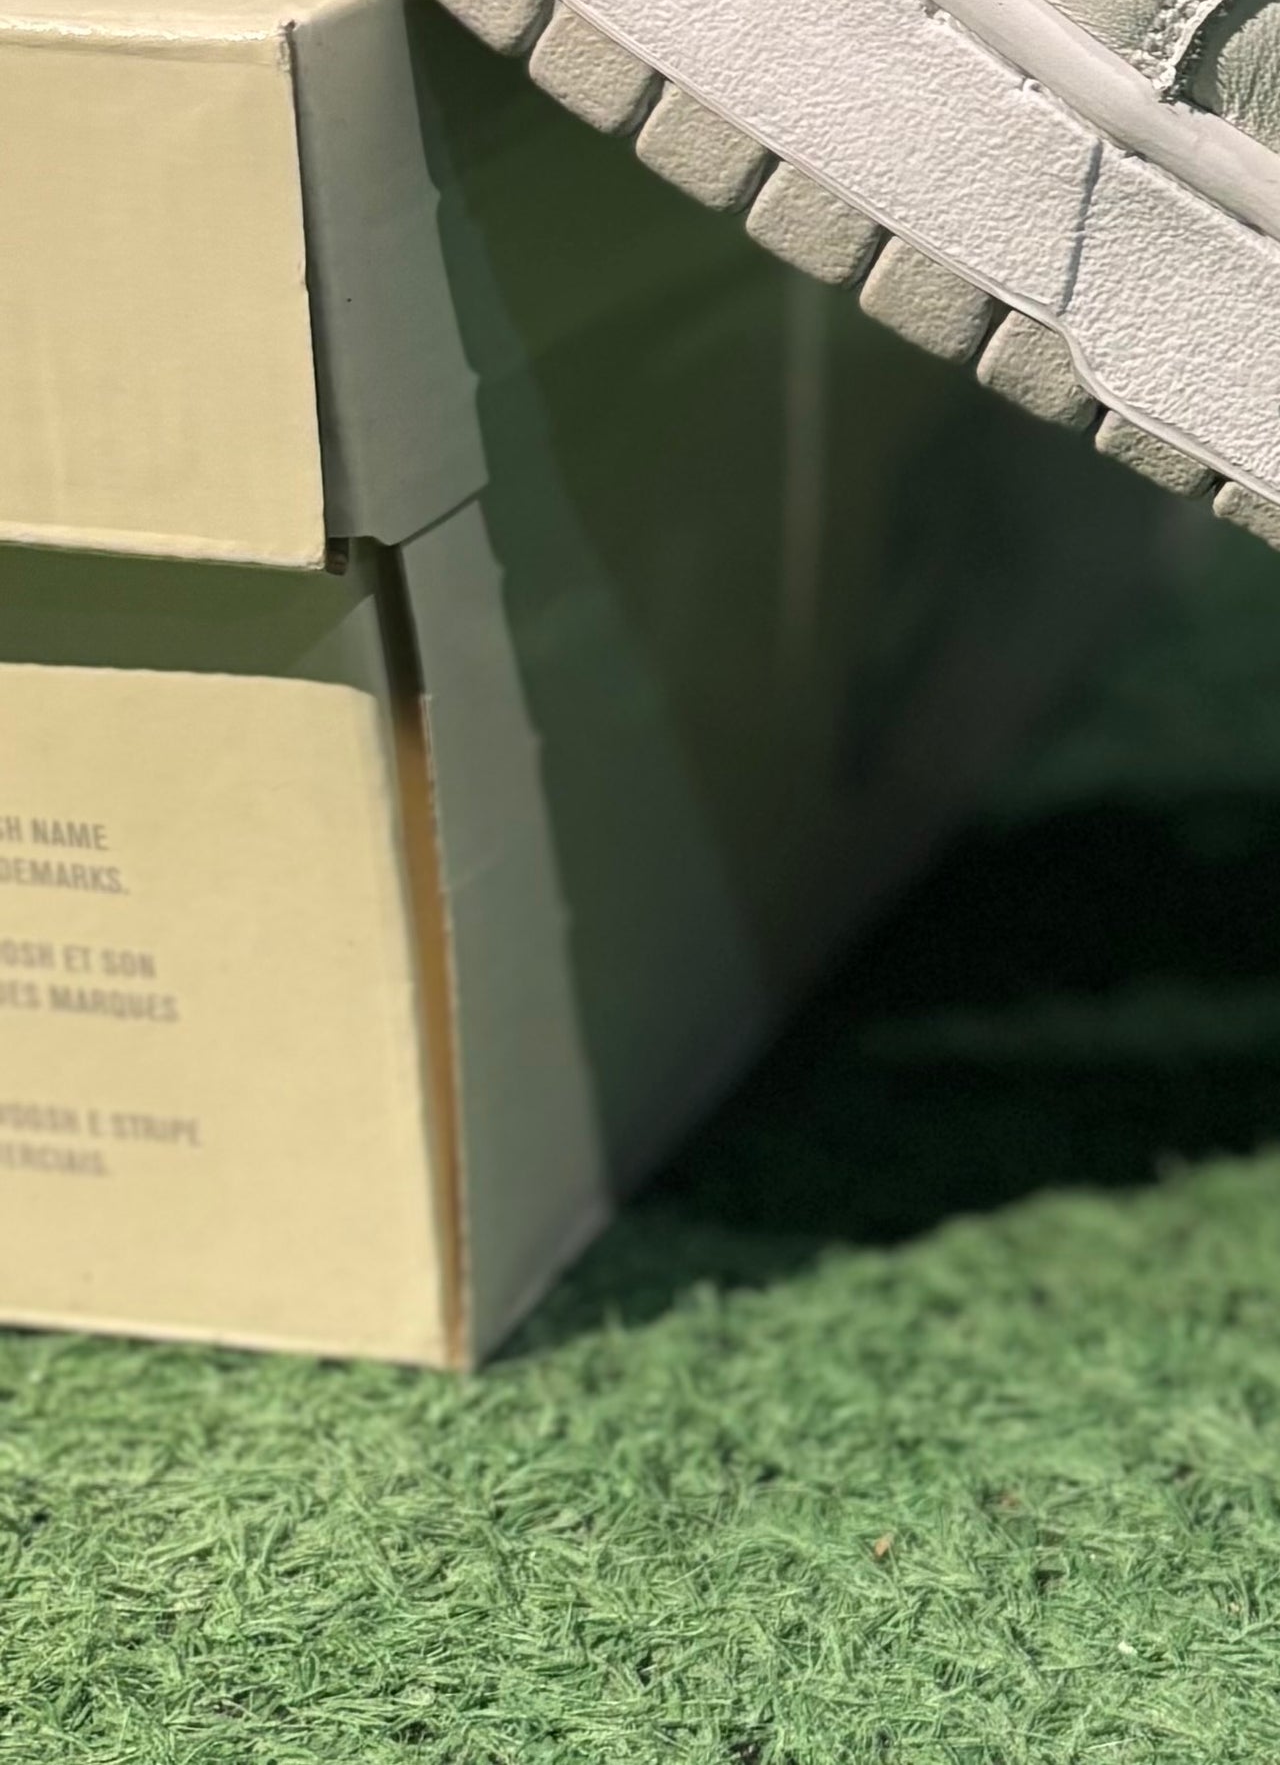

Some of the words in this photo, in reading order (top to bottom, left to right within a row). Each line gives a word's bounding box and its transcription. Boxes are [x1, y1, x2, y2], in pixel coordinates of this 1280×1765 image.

[31, 817, 109, 851] NAME
[63, 944, 91, 973] ET
[101, 948, 155, 979] SON
